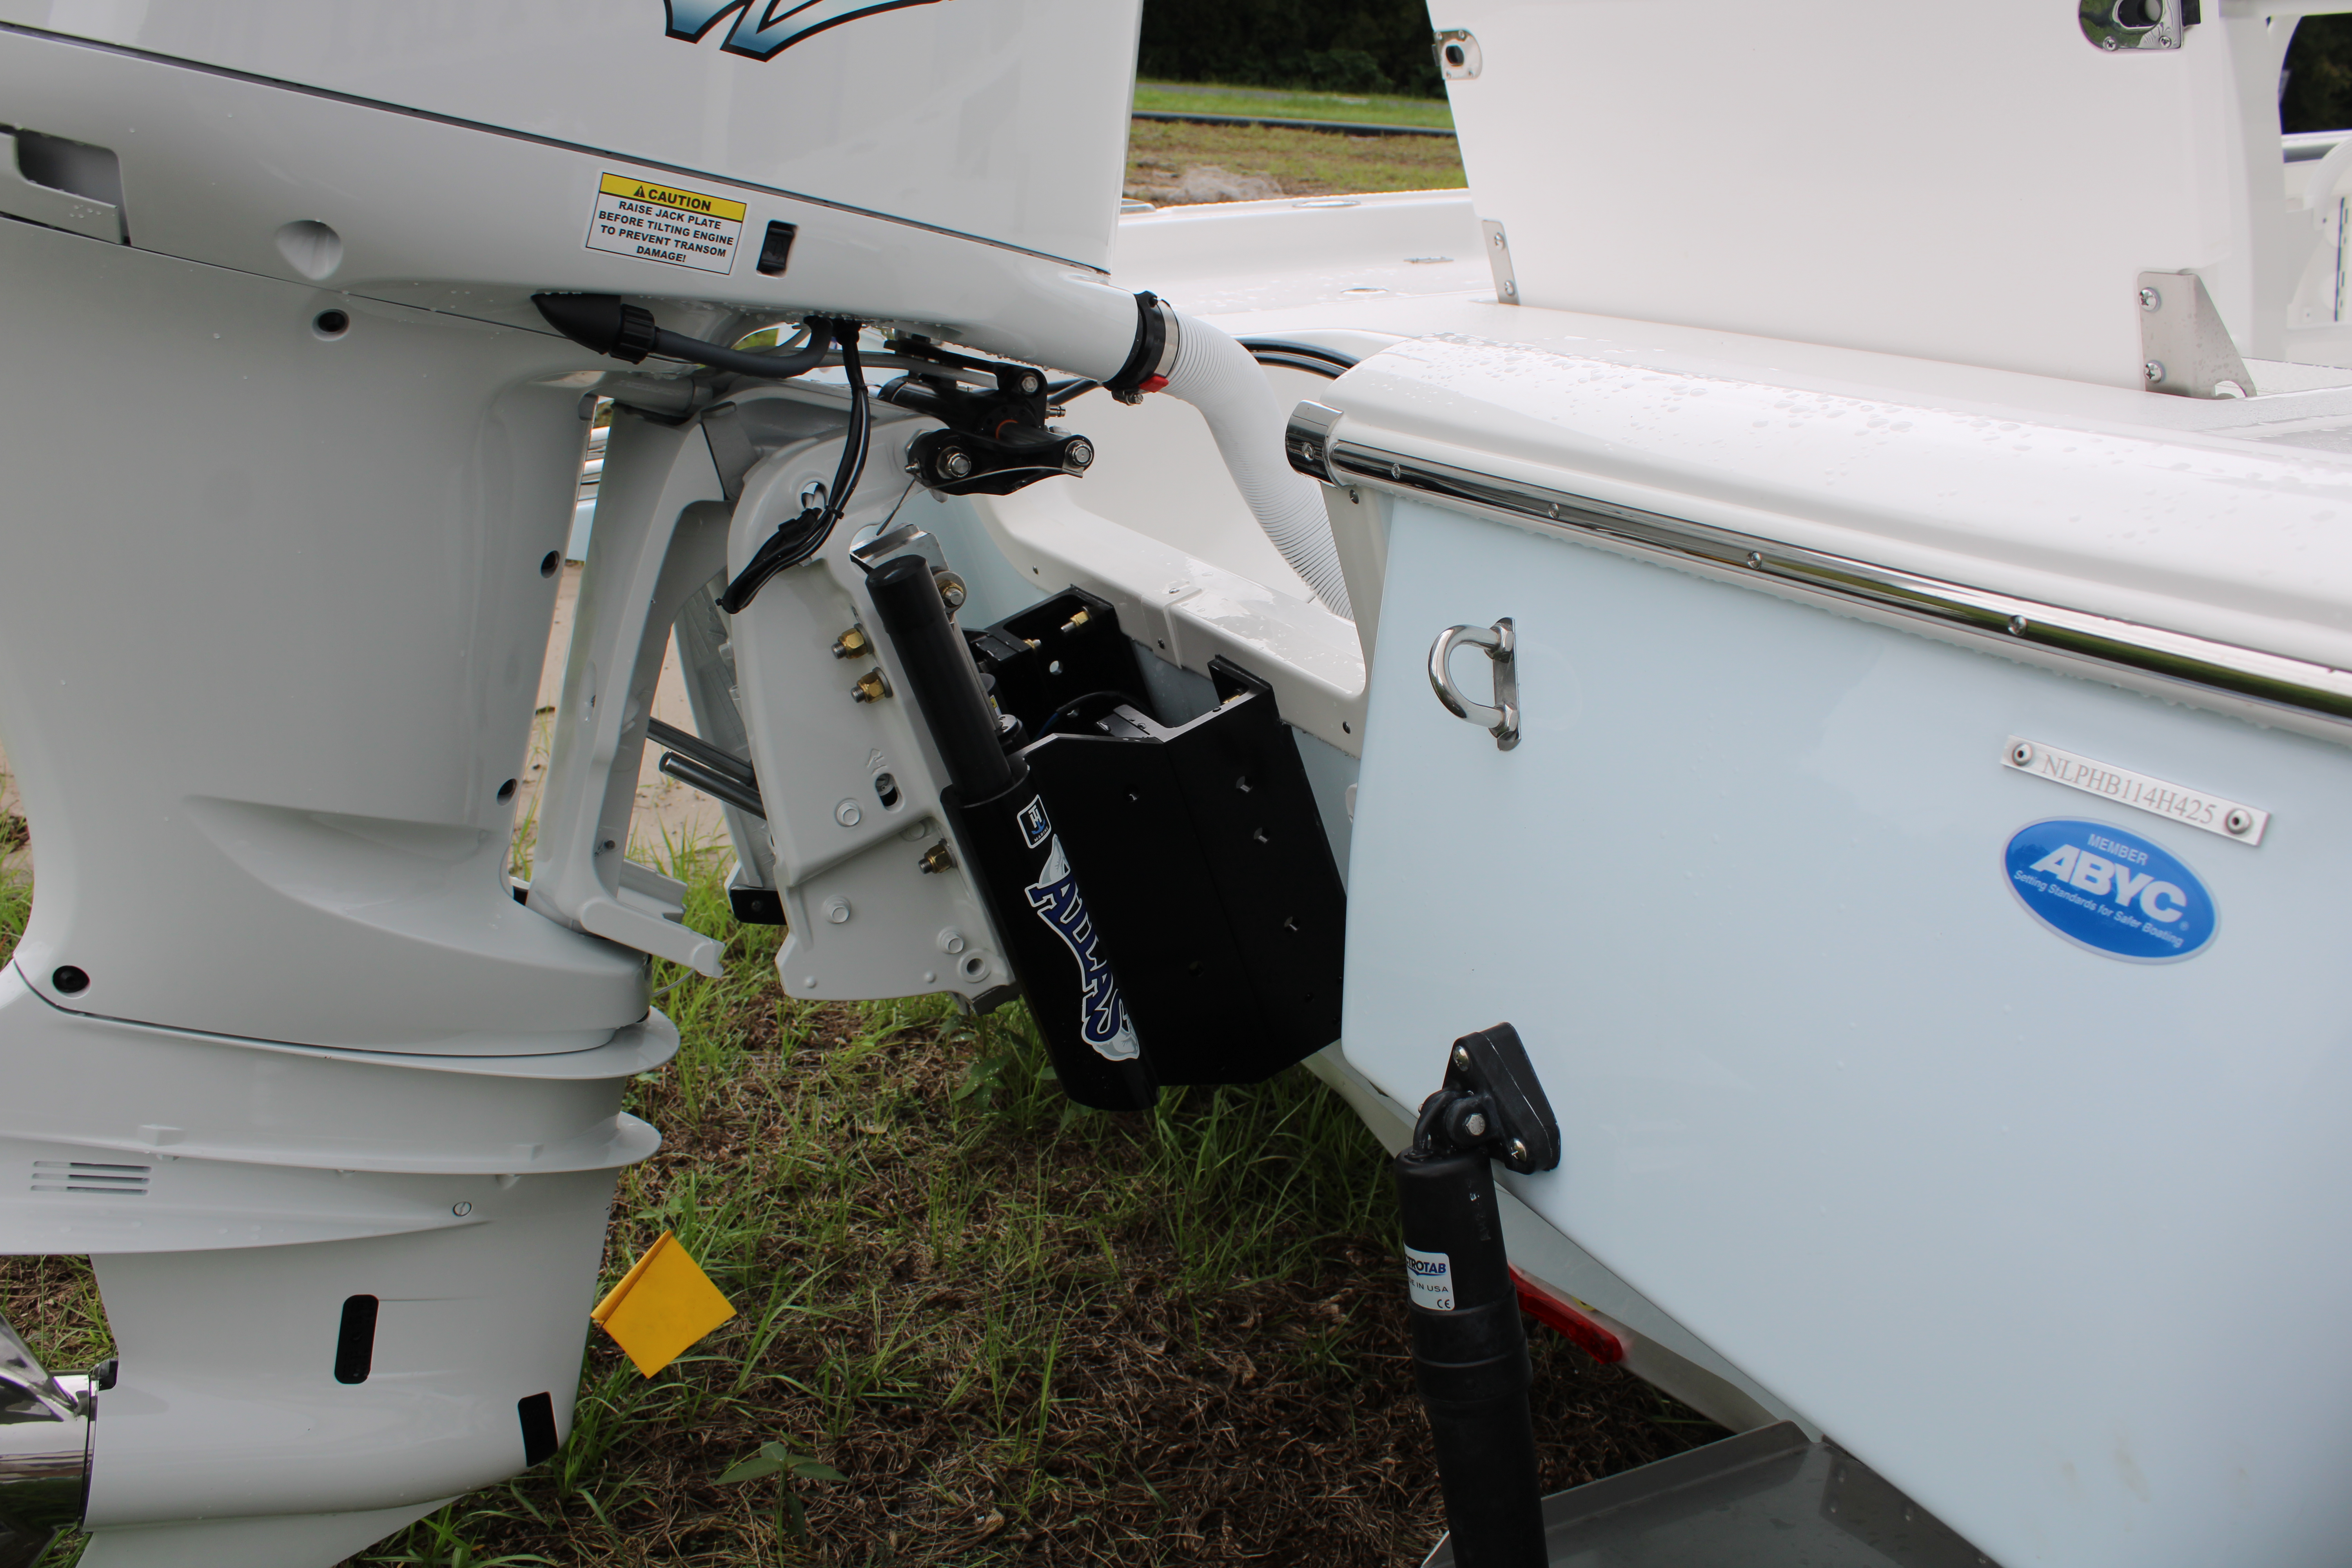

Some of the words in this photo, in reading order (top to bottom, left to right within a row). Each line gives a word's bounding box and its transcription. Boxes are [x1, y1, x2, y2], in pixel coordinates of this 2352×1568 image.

[619, 200, 652, 215] RAISE
[655, 209, 685, 222] JACK
[688, 216, 721, 229] PLATE
[648, 189, 711, 211] CAUTION
[599, 211, 643, 227] BEFORE
[648, 221, 690, 237] TILTING
[693, 230, 734, 246] ENGINE
[601, 225, 615, 235] TO
[619, 229, 671, 246] PREVENT
[674, 240, 726, 258] TRANSOM
[636, 246, 686, 262] DAMAGE!
[2041, 754, 2217, 824] NLPHB114H425
[1034, 826, 1049, 842] MARINE
[2087, 834, 2149, 865] MEMBER
[2029, 844, 2187, 923] ABYC
[2014, 870, 2047, 892] Setting
[2049, 884, 2097, 911] Standards
[2098, 904, 2114, 917] for
[2113, 911, 2142, 929] Safer
[2142, 923, 2184, 948] Boating
